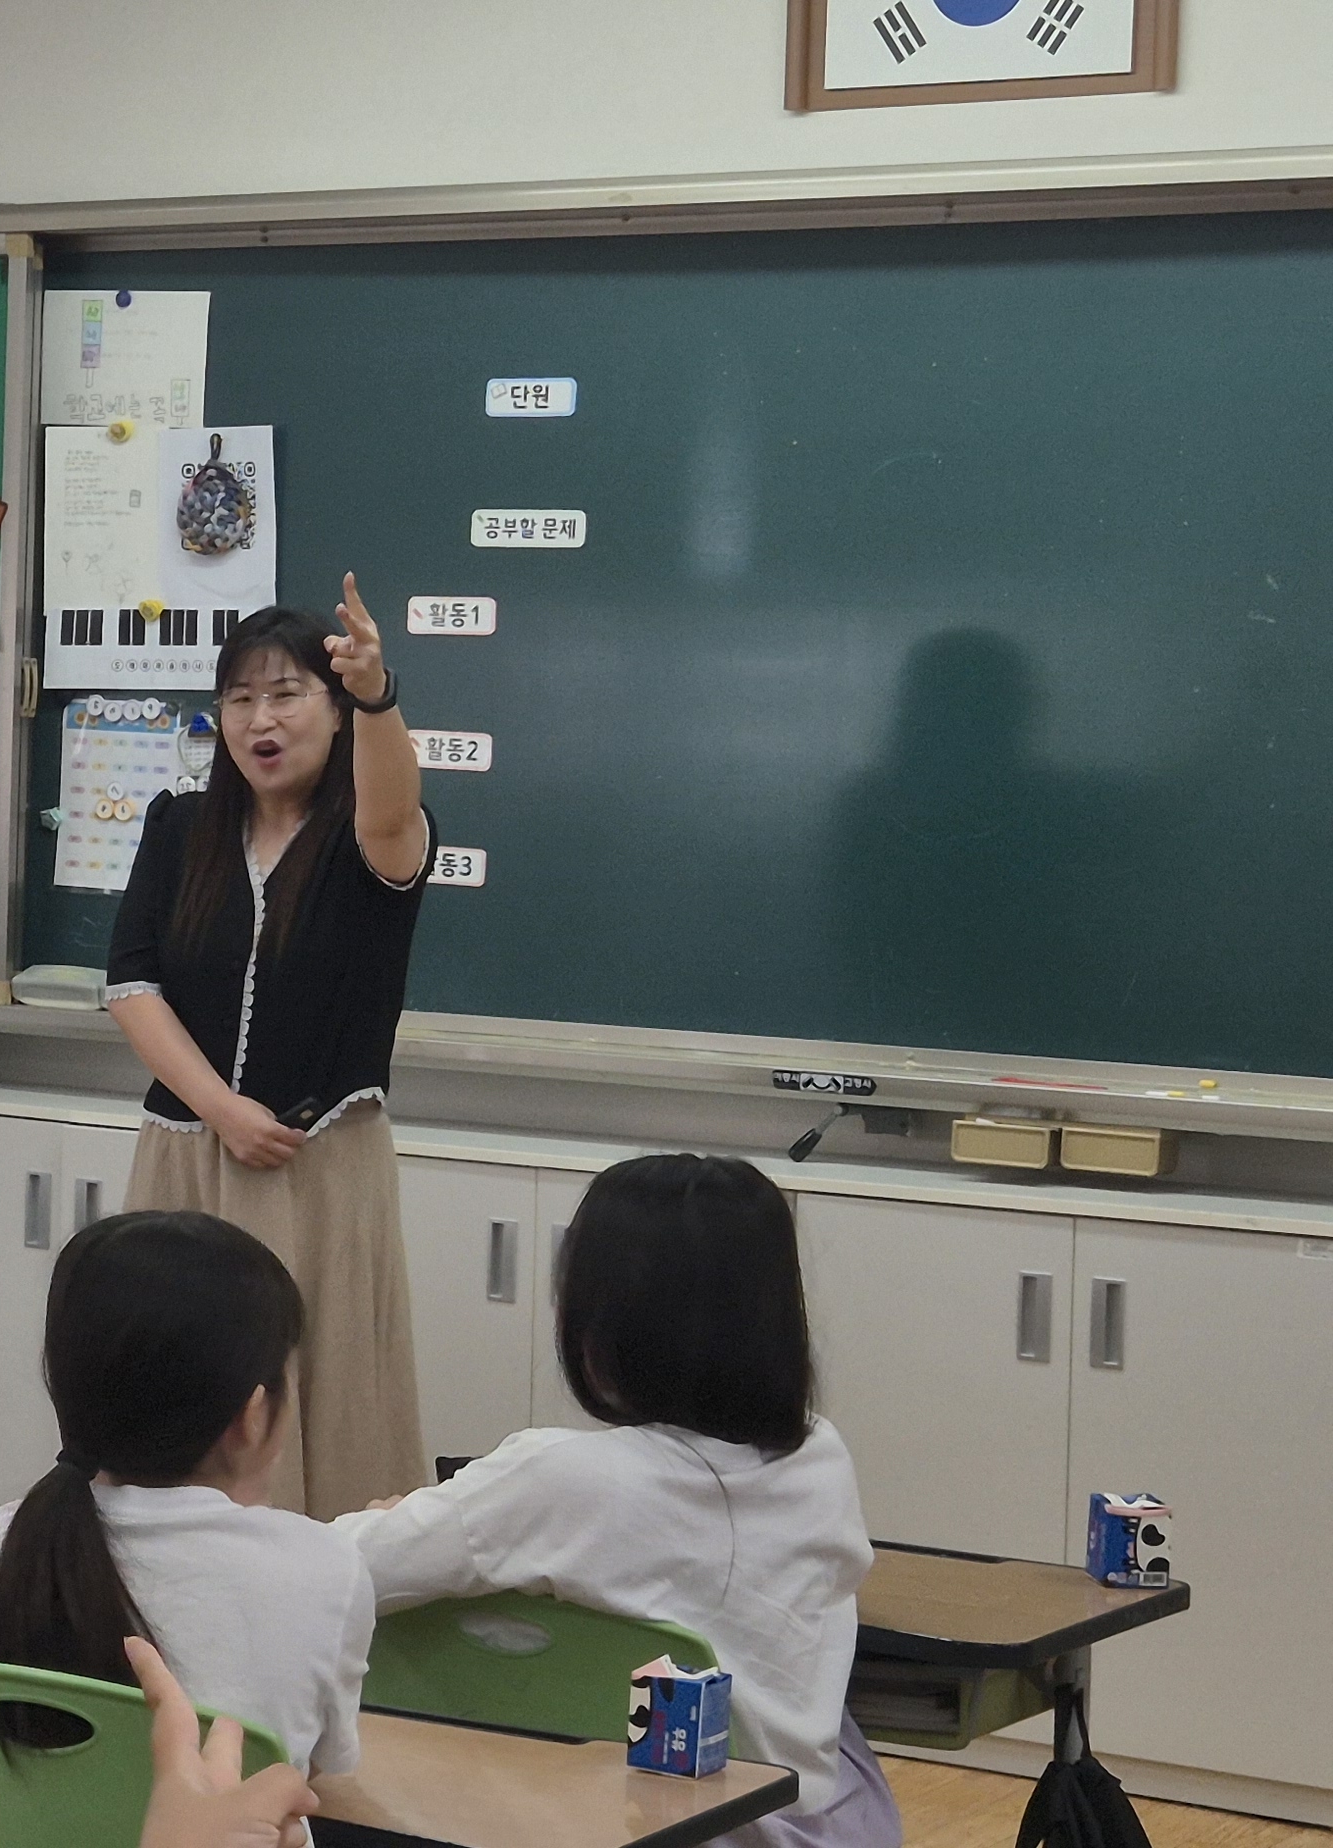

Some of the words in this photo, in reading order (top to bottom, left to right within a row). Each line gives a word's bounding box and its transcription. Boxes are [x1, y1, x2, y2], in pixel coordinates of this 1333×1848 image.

[510, 384, 550, 409] 단원
[483, 516, 537, 540] 공부할
[541, 517, 577, 540] 문제
[429, 602, 479, 628] 활동1
[425, 736, 479, 763] 활동2
[433, 852, 472, 878] 동3
